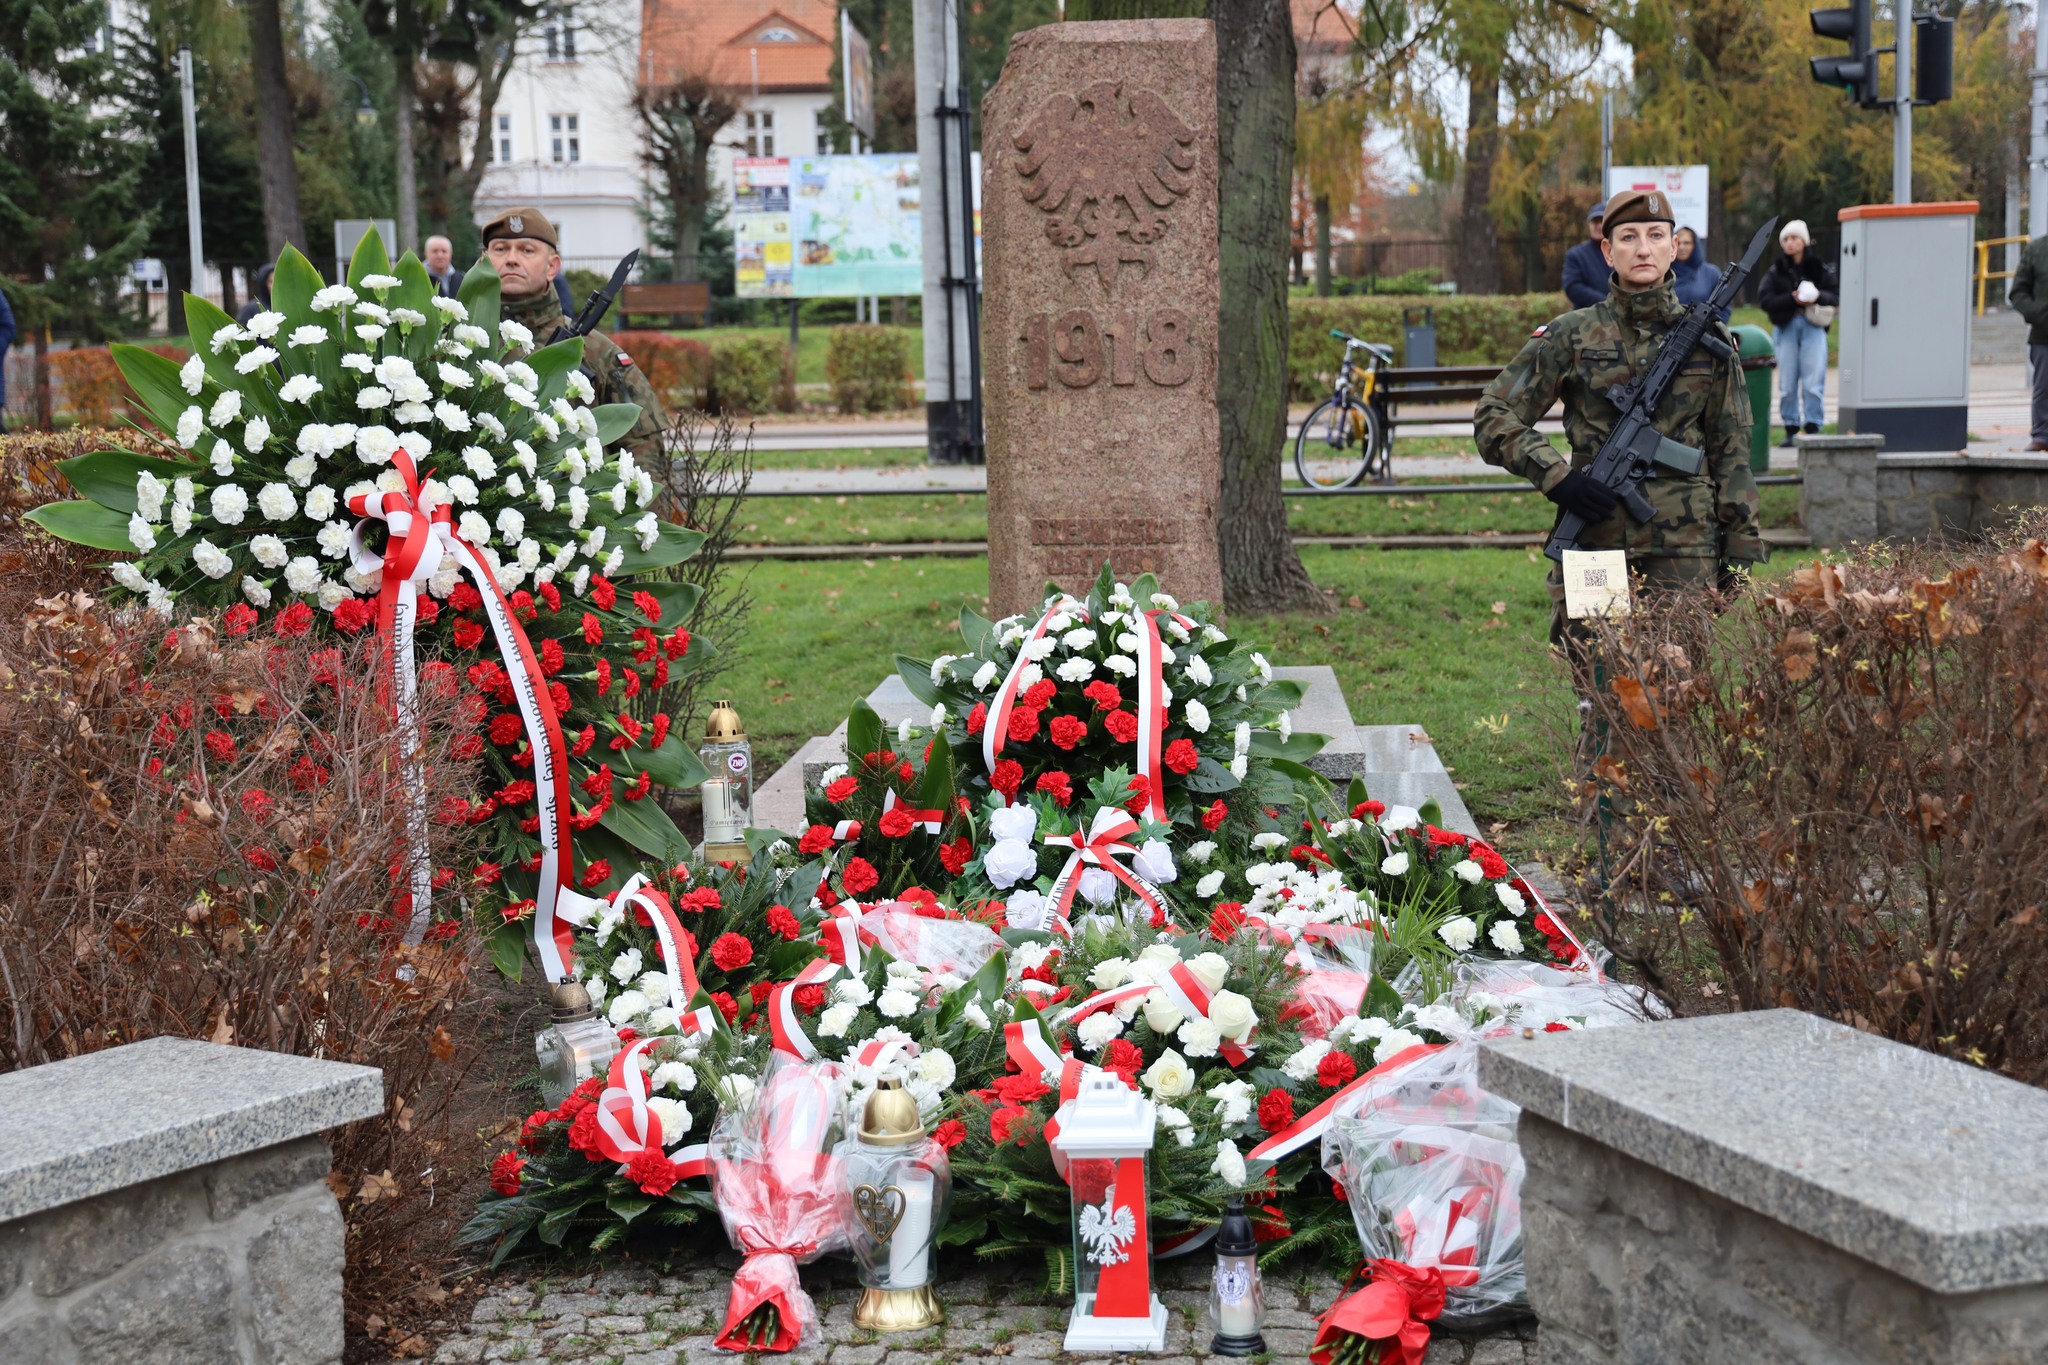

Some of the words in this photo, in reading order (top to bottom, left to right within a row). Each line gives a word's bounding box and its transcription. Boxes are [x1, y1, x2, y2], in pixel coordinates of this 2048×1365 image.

[1020, 308, 1196, 389] 1918
[495, 599, 529, 664] Ostrowi
[521, 671, 562, 782] Mazowieckiej
